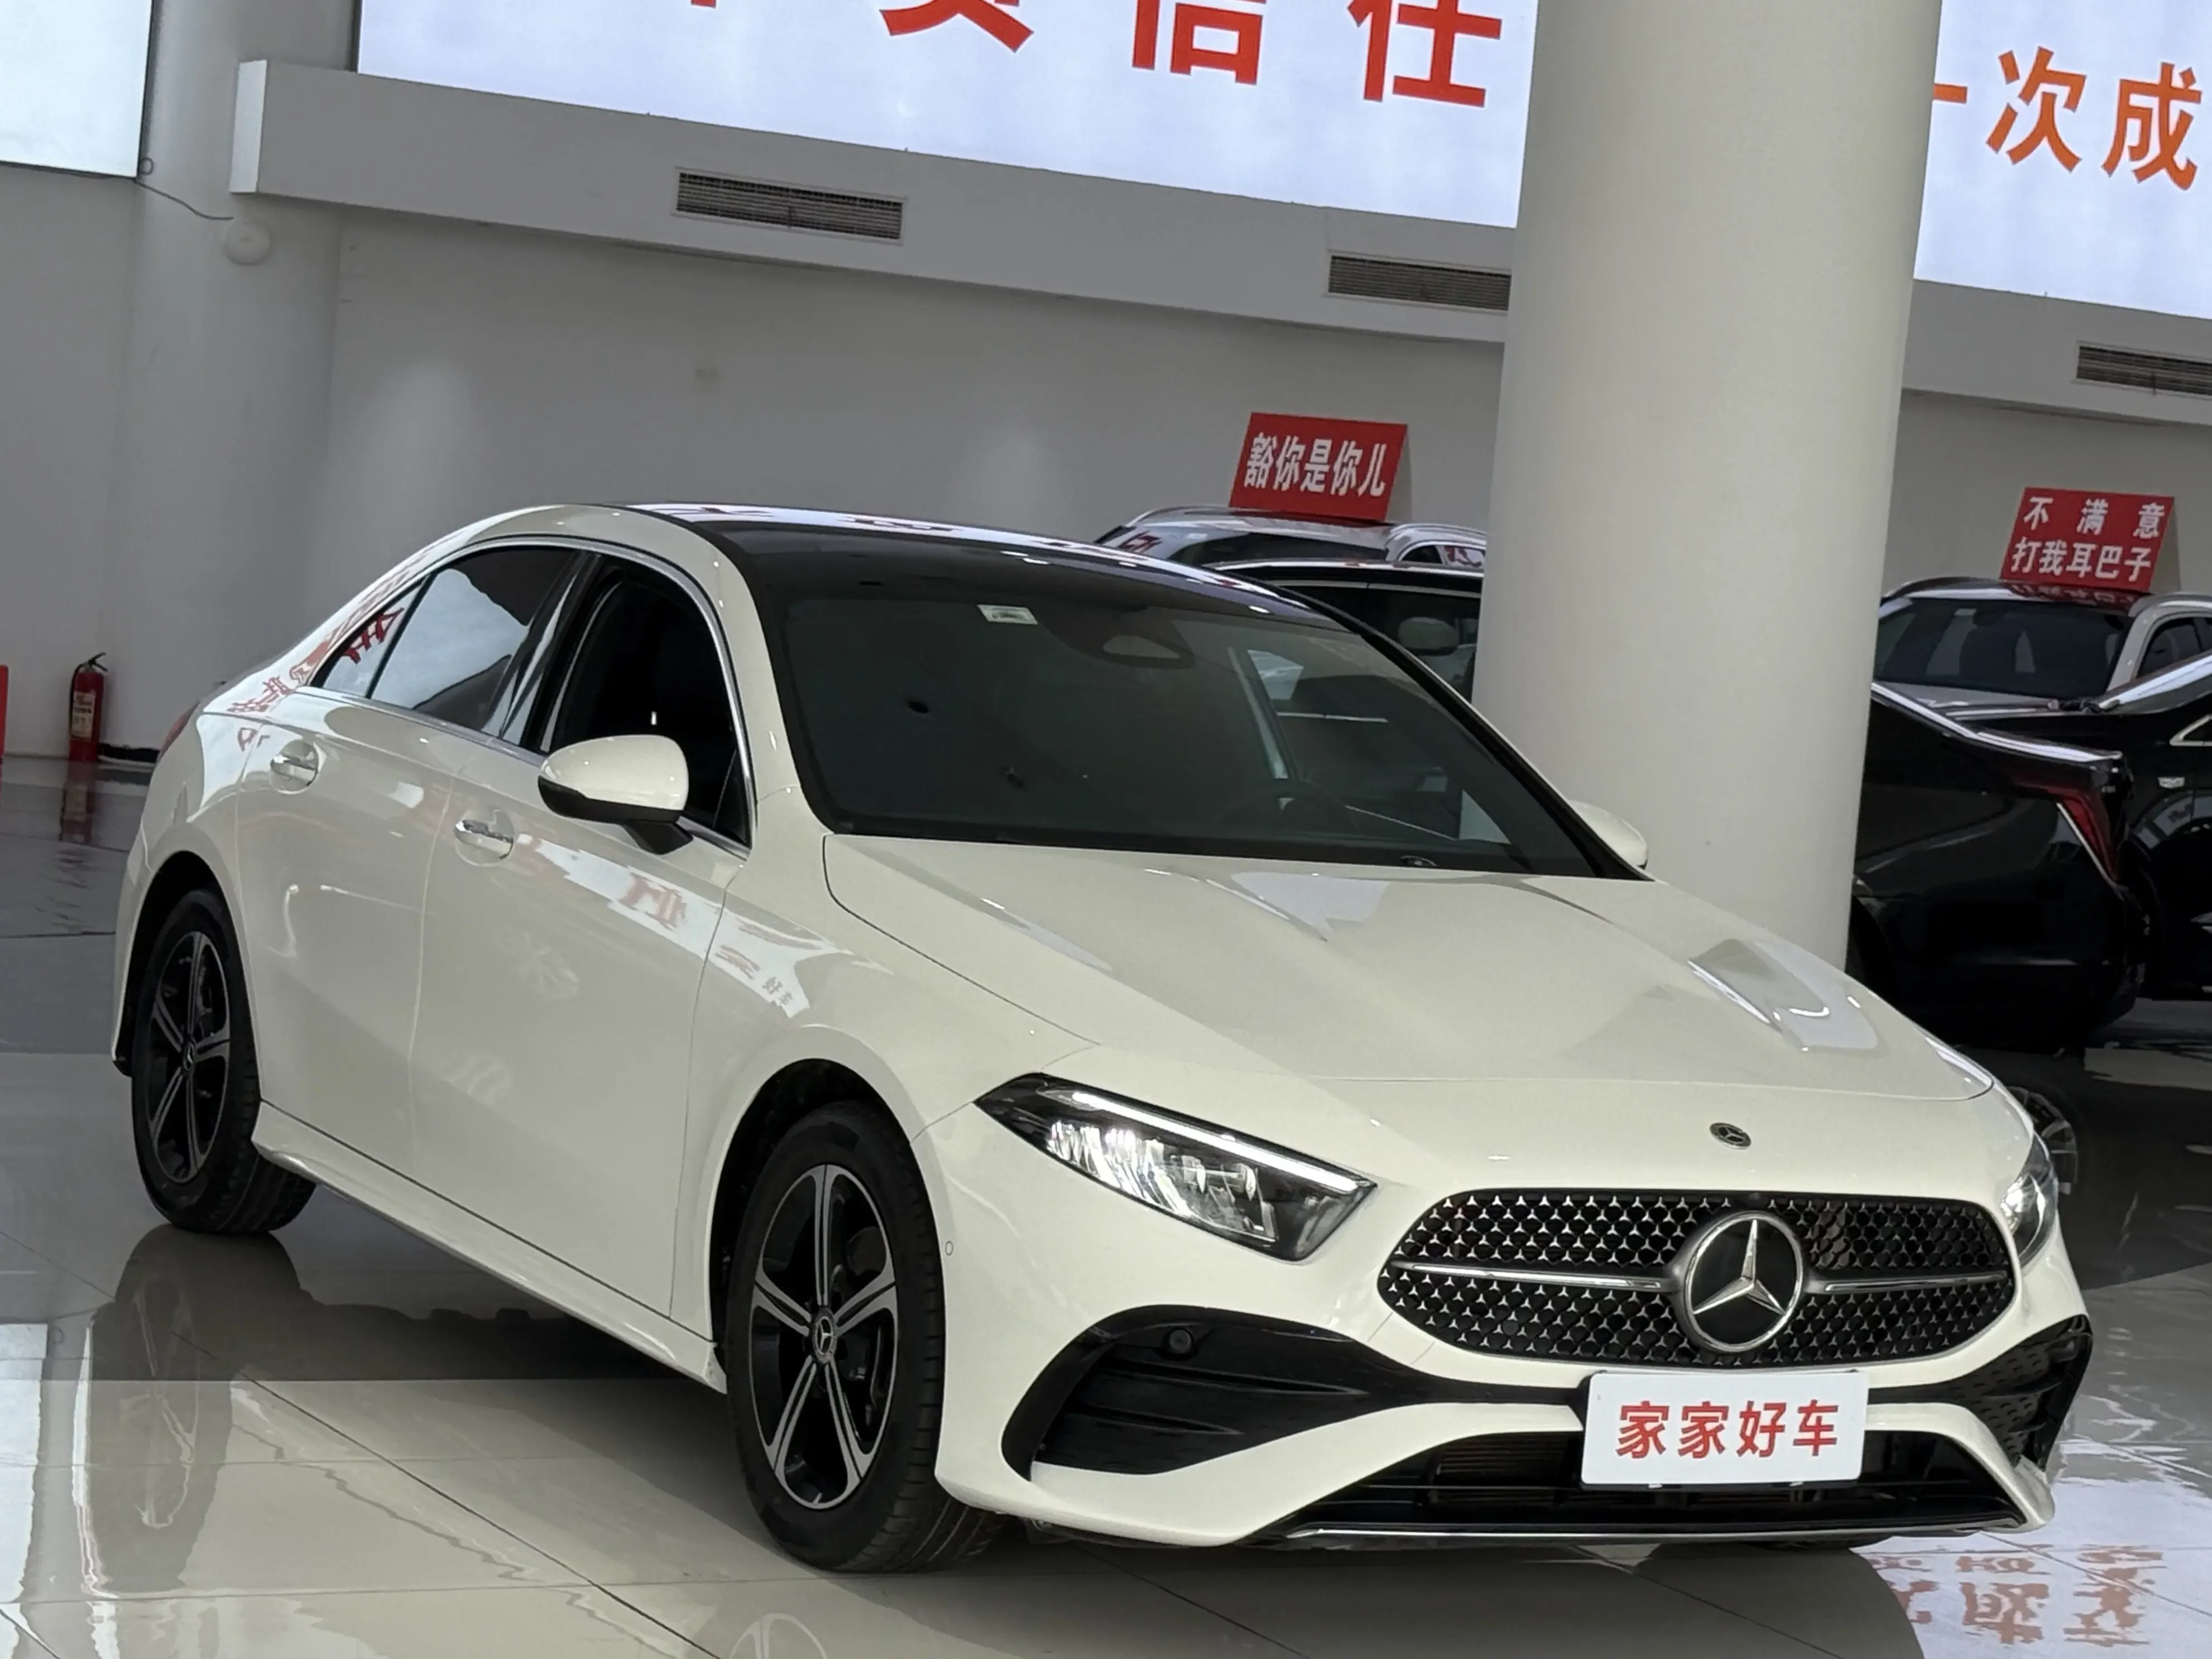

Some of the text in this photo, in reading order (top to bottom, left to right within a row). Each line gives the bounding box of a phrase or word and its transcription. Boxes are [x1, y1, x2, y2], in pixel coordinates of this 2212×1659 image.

[2011, 536, 2152, 582] 打我耳巴子
[1615, 1399, 1839, 1459] 家家好车
